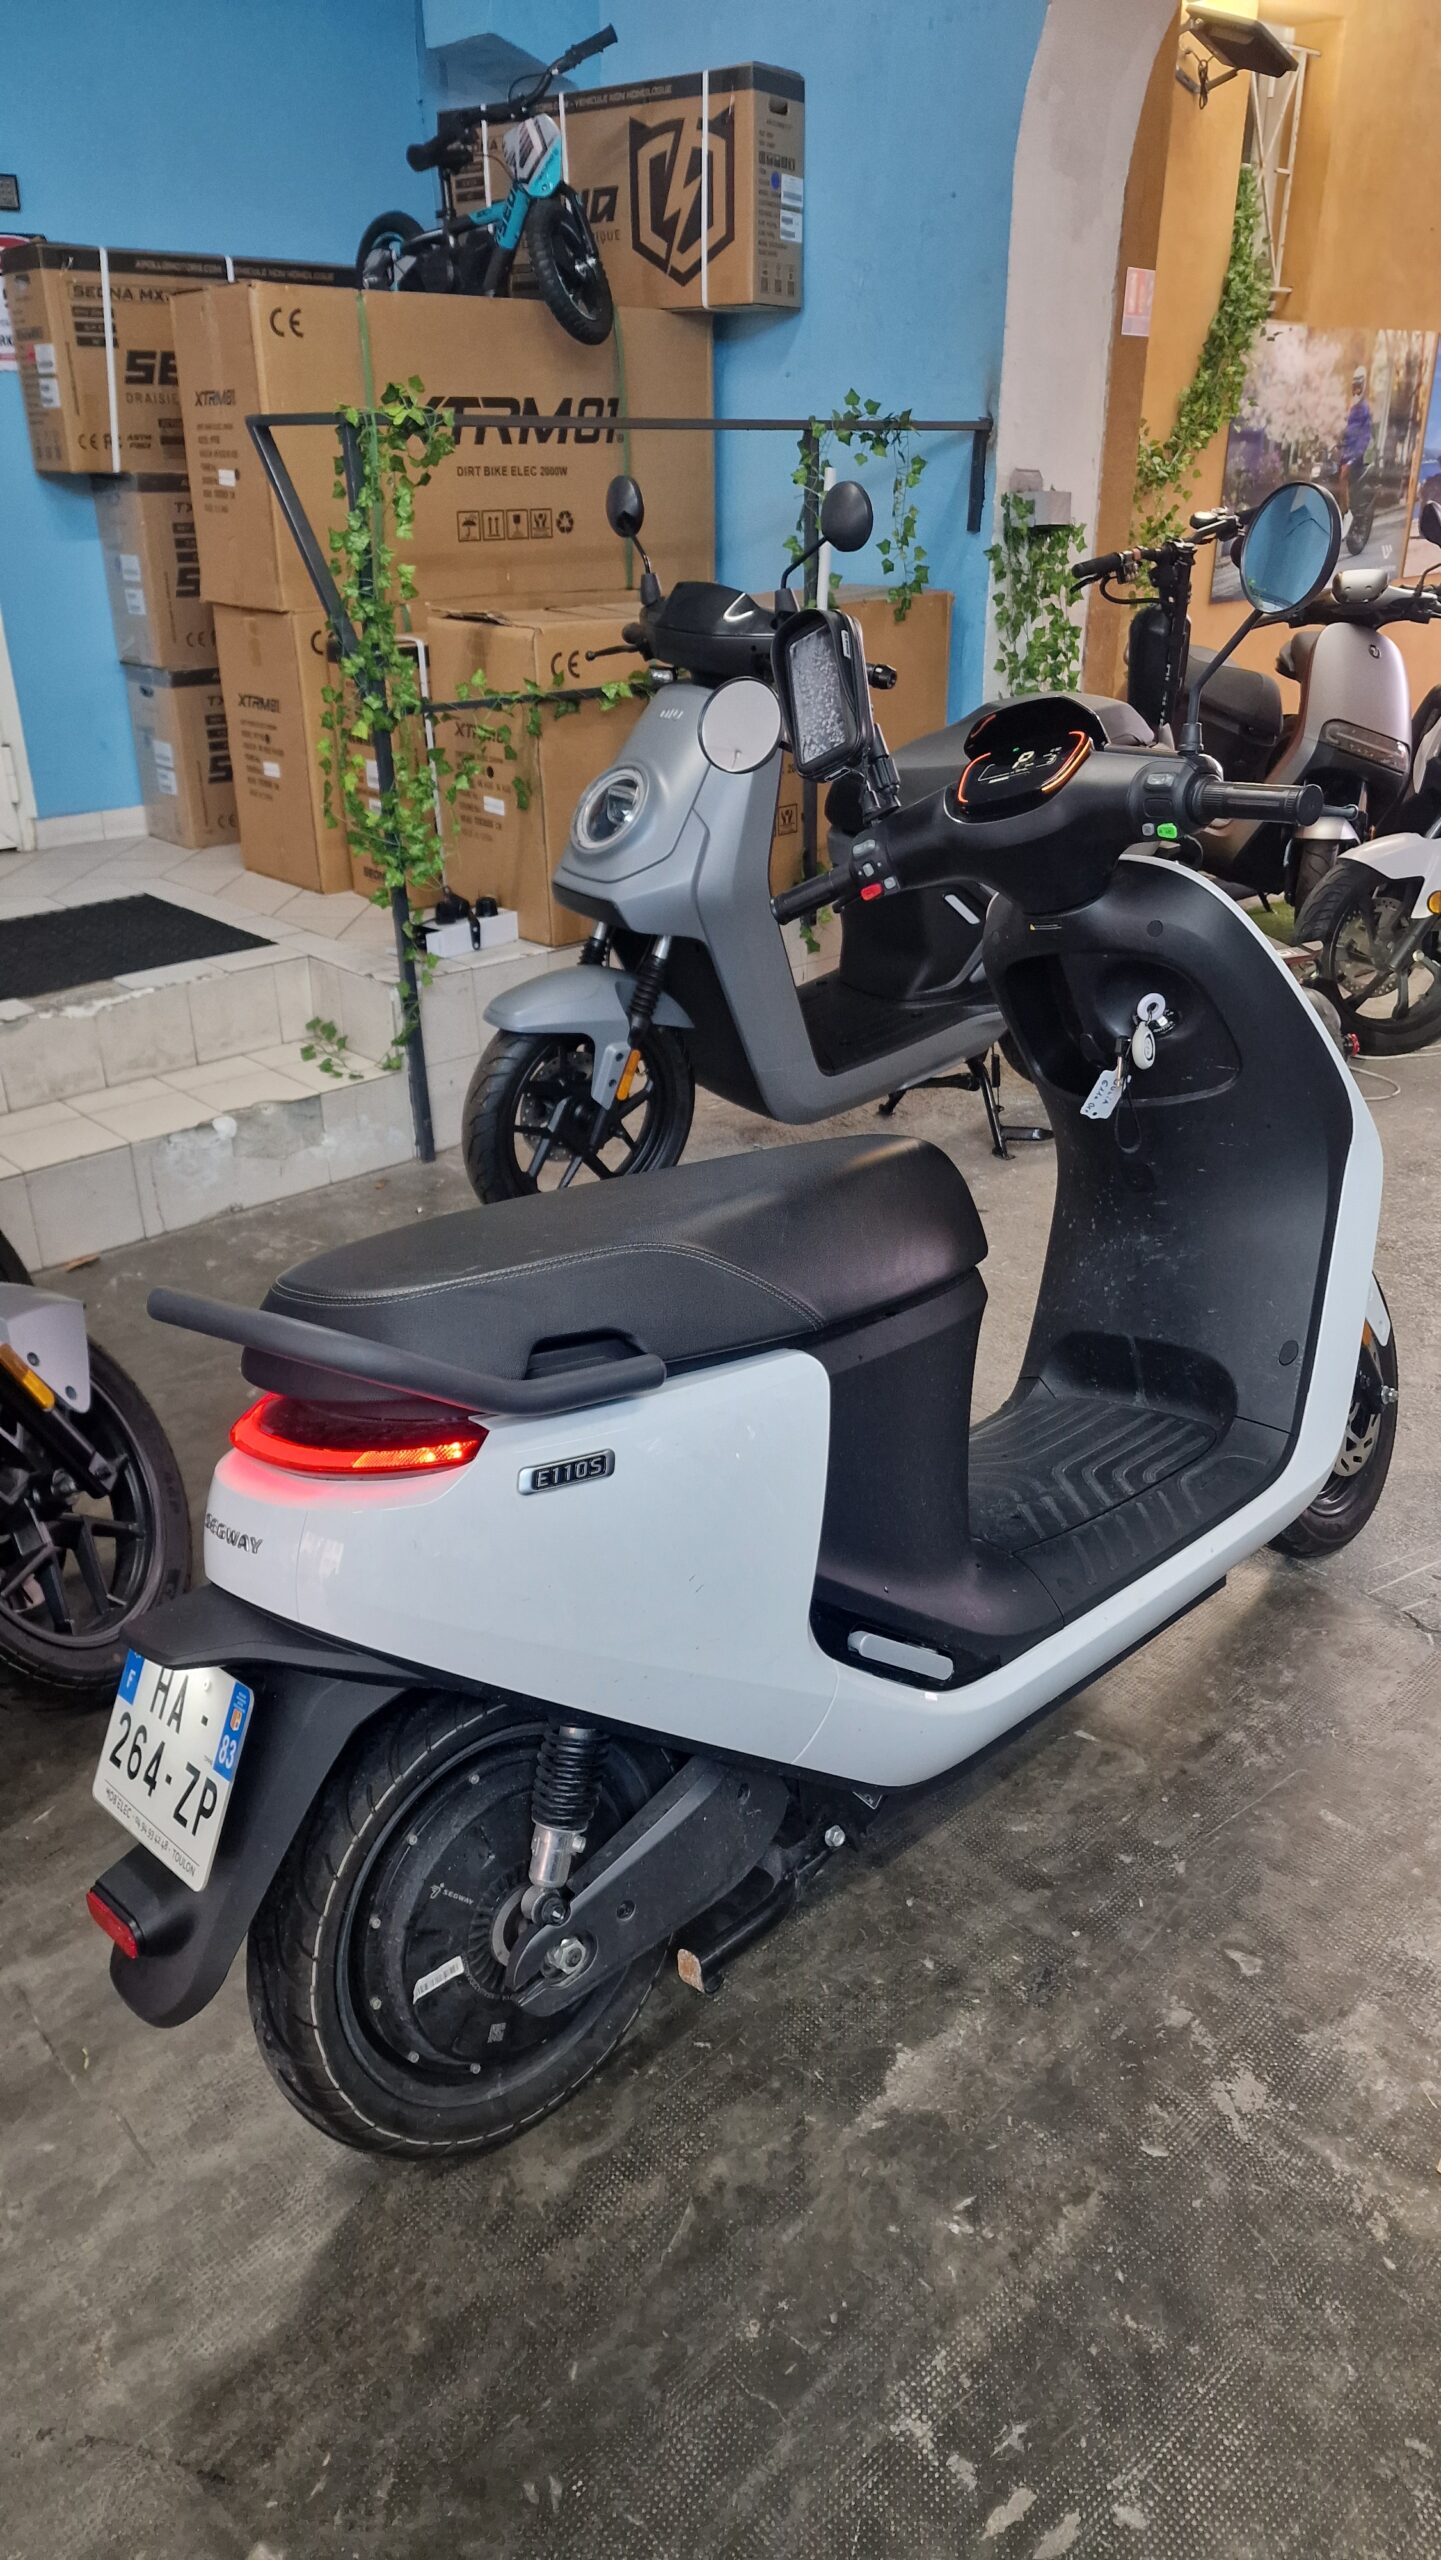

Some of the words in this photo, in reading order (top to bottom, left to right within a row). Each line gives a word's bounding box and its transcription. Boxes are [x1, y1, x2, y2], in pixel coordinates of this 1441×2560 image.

[456, 465, 480, 478] DIRT
[484, 465, 508, 477] BIKE
[510, 465, 537, 477] ELEC
[535, 1457, 604, 1489] E110S
[204, 1512, 264, 1555] SEGWAY
[126, 1668, 137, 1689] F
[218, 1734, 237, 1770] 83
[171, 1847, 196, 1877] TOULON
[442, 1889, 475, 1905] SEGWAY
